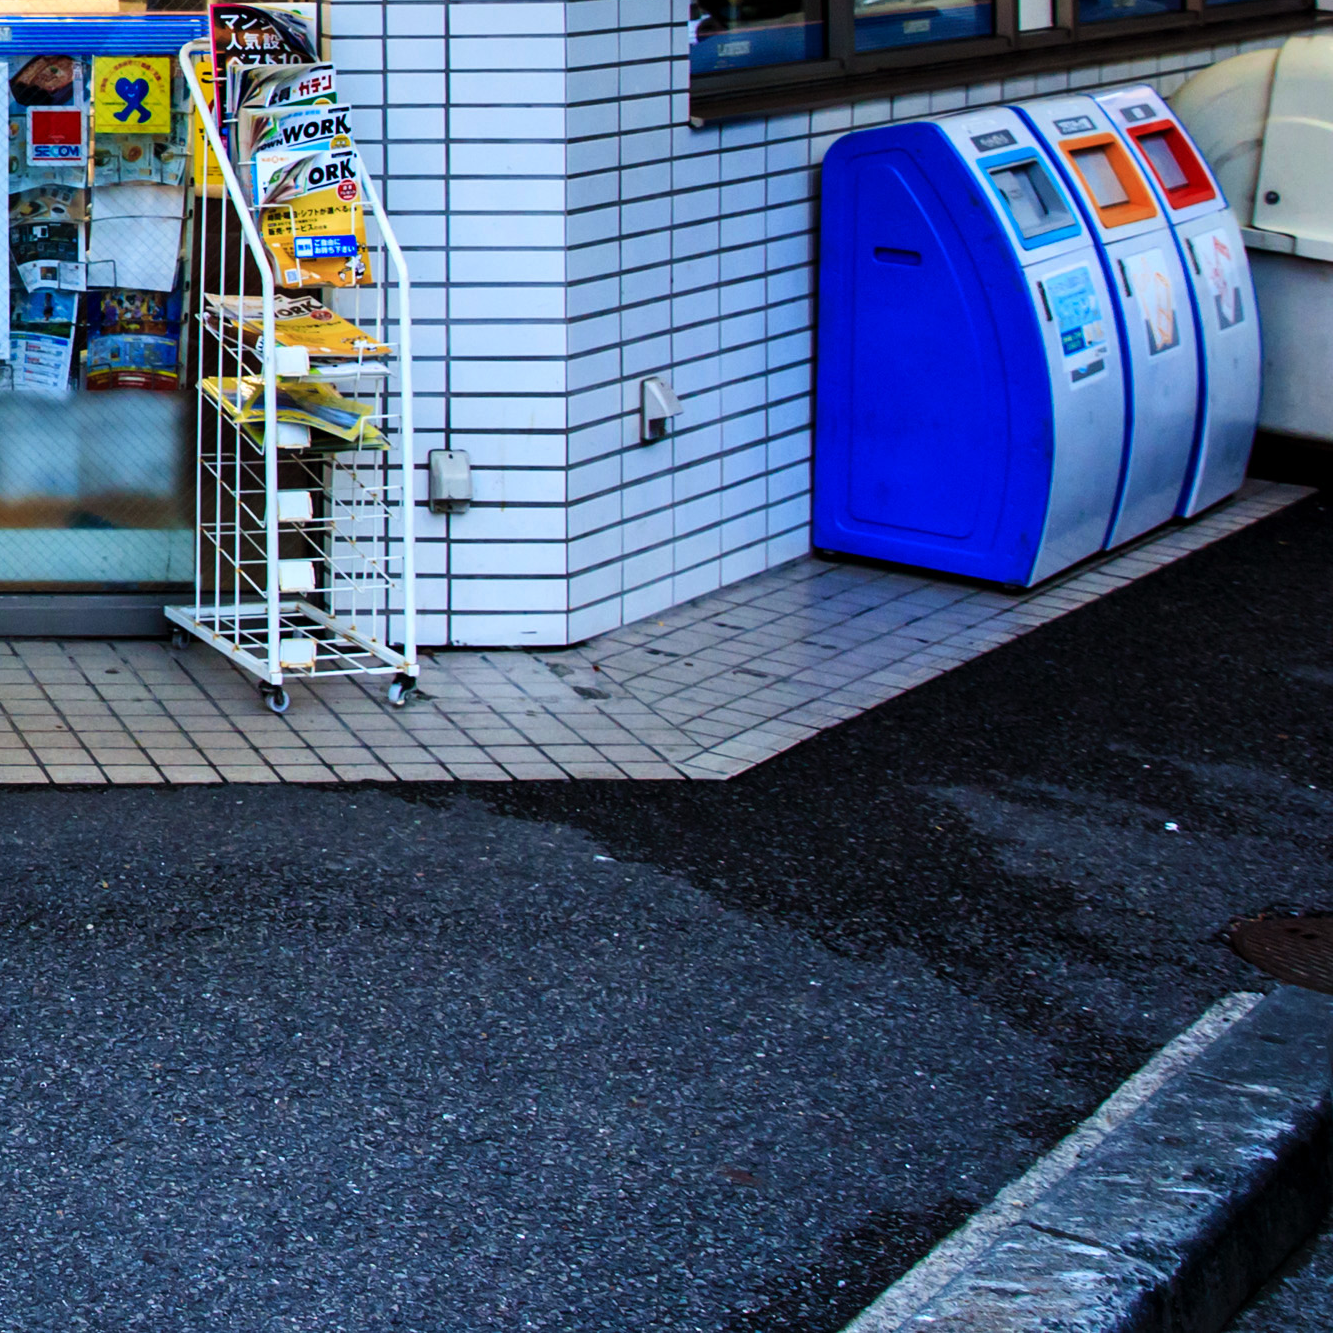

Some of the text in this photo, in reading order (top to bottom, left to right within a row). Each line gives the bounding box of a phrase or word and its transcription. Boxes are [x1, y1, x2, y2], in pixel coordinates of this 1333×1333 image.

[282, 113, 352, 144] WORK
[34, 145, 80, 157] SECOM
[307, 157, 356, 185] ORK
[297, 244, 312, 252] 無料
[314, 238, 341, 247] ご自由に
[314, 246, 356, 255] お持ち下さい
[275, 300, 324, 319] ORK
